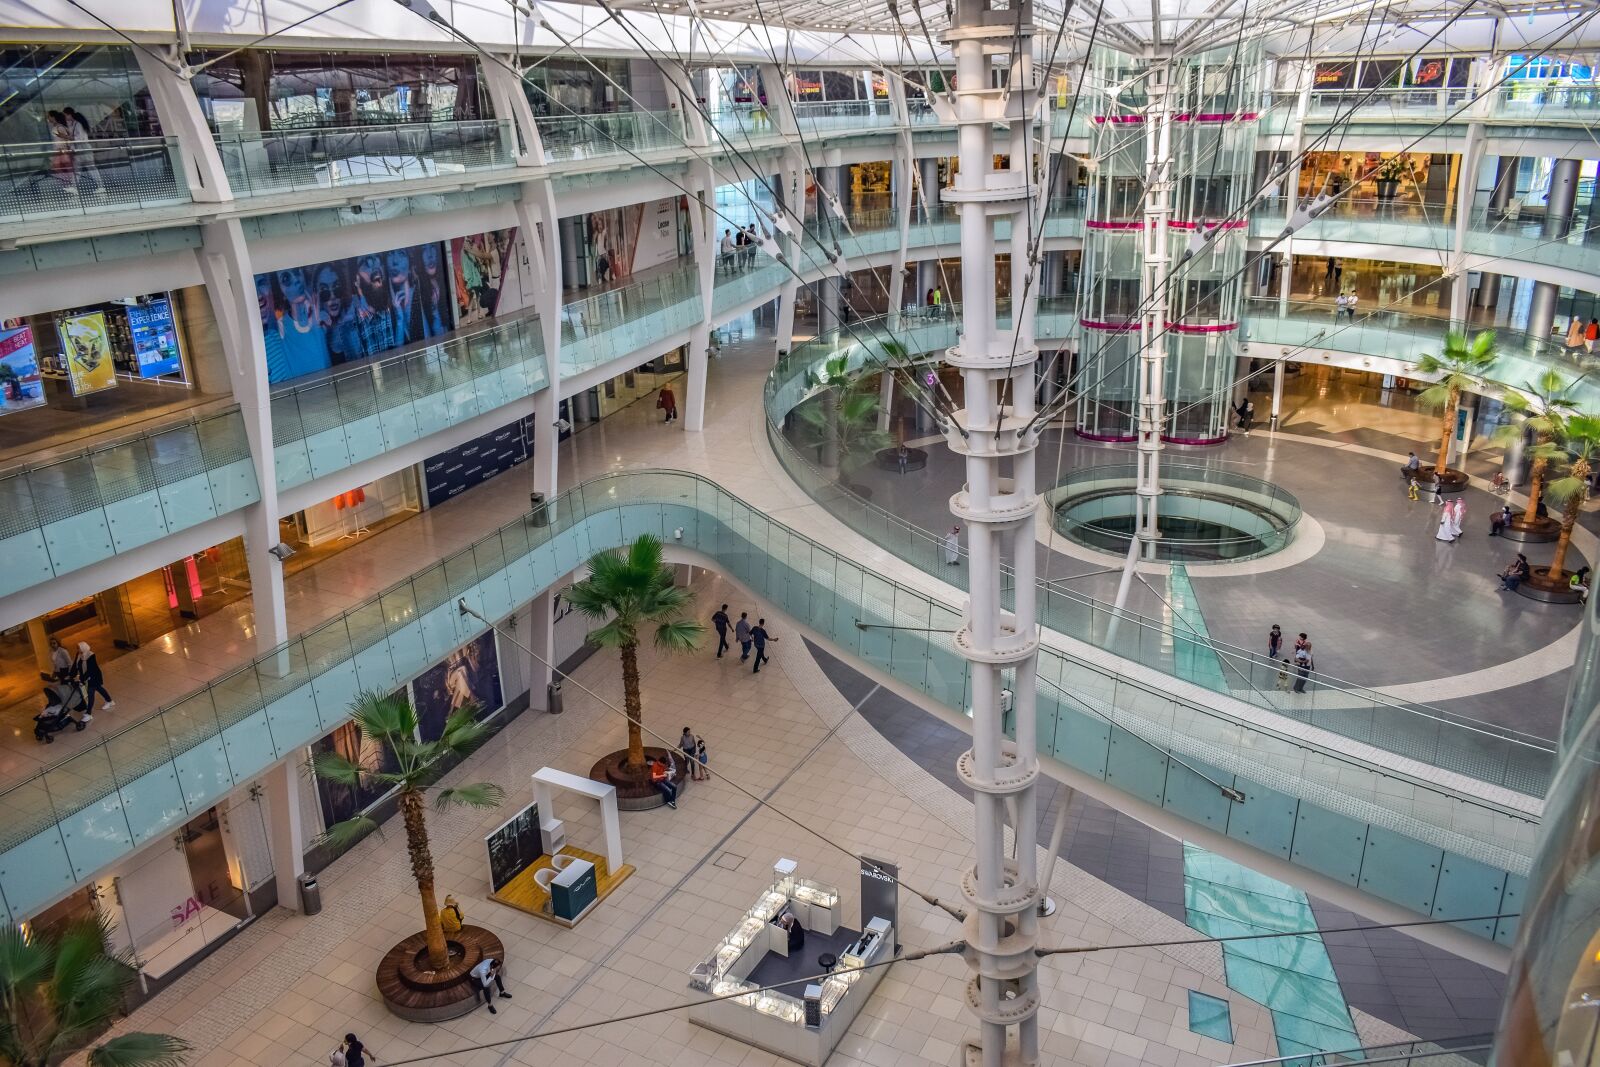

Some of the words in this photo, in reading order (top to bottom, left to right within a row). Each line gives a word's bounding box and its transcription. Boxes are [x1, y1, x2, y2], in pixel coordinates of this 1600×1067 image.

[131, 311, 170, 326] EXPERIENCE
[13, 331, 26, 343] BEAT
[927, 373, 934, 385] 3
[861, 869, 894, 883] SWAROVSKI
[170, 880, 220, 928] SALE
